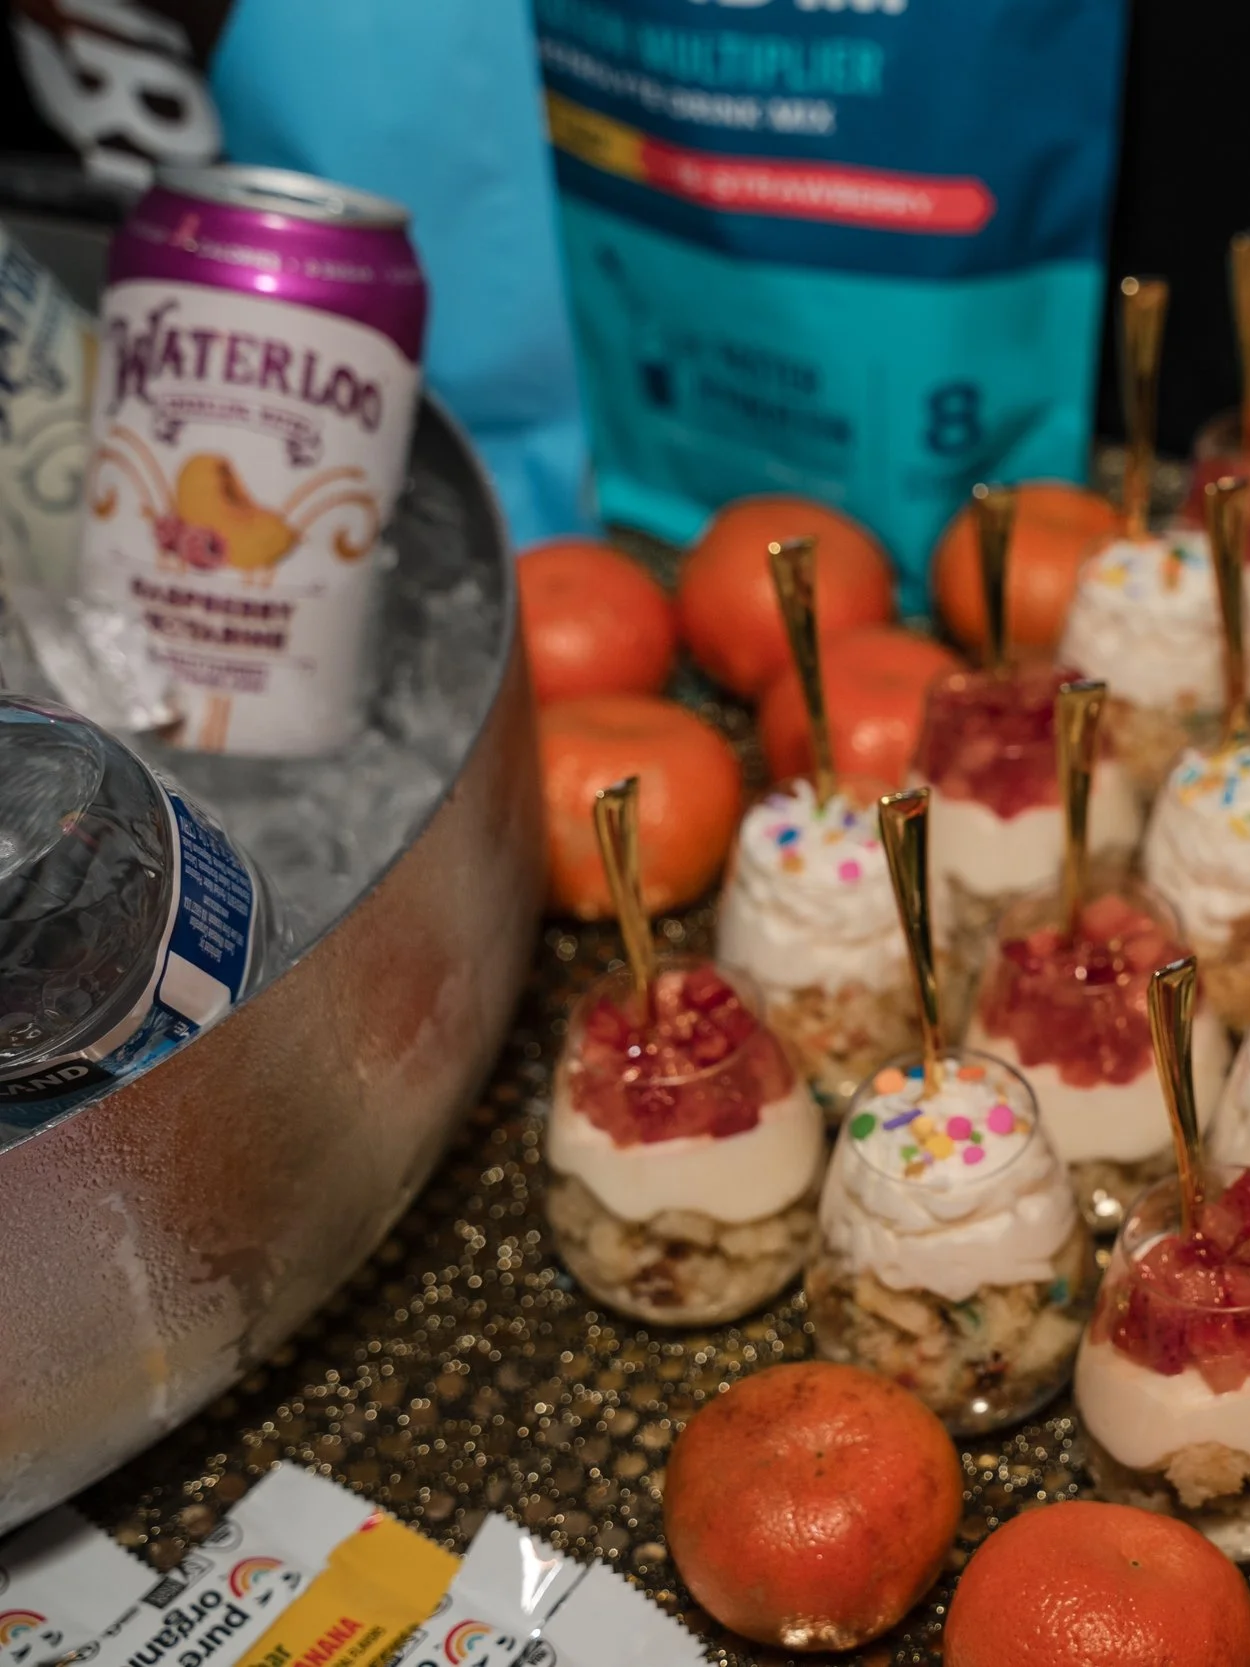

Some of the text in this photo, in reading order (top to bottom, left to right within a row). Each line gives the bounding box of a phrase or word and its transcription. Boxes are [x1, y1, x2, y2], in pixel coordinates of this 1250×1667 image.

[637, 26, 885, 96] MULTIPLIER
[105, 298, 384, 434] WATERLOO
[926, 382, 983, 455] 8
[178, 1602, 252, 1667] pure
